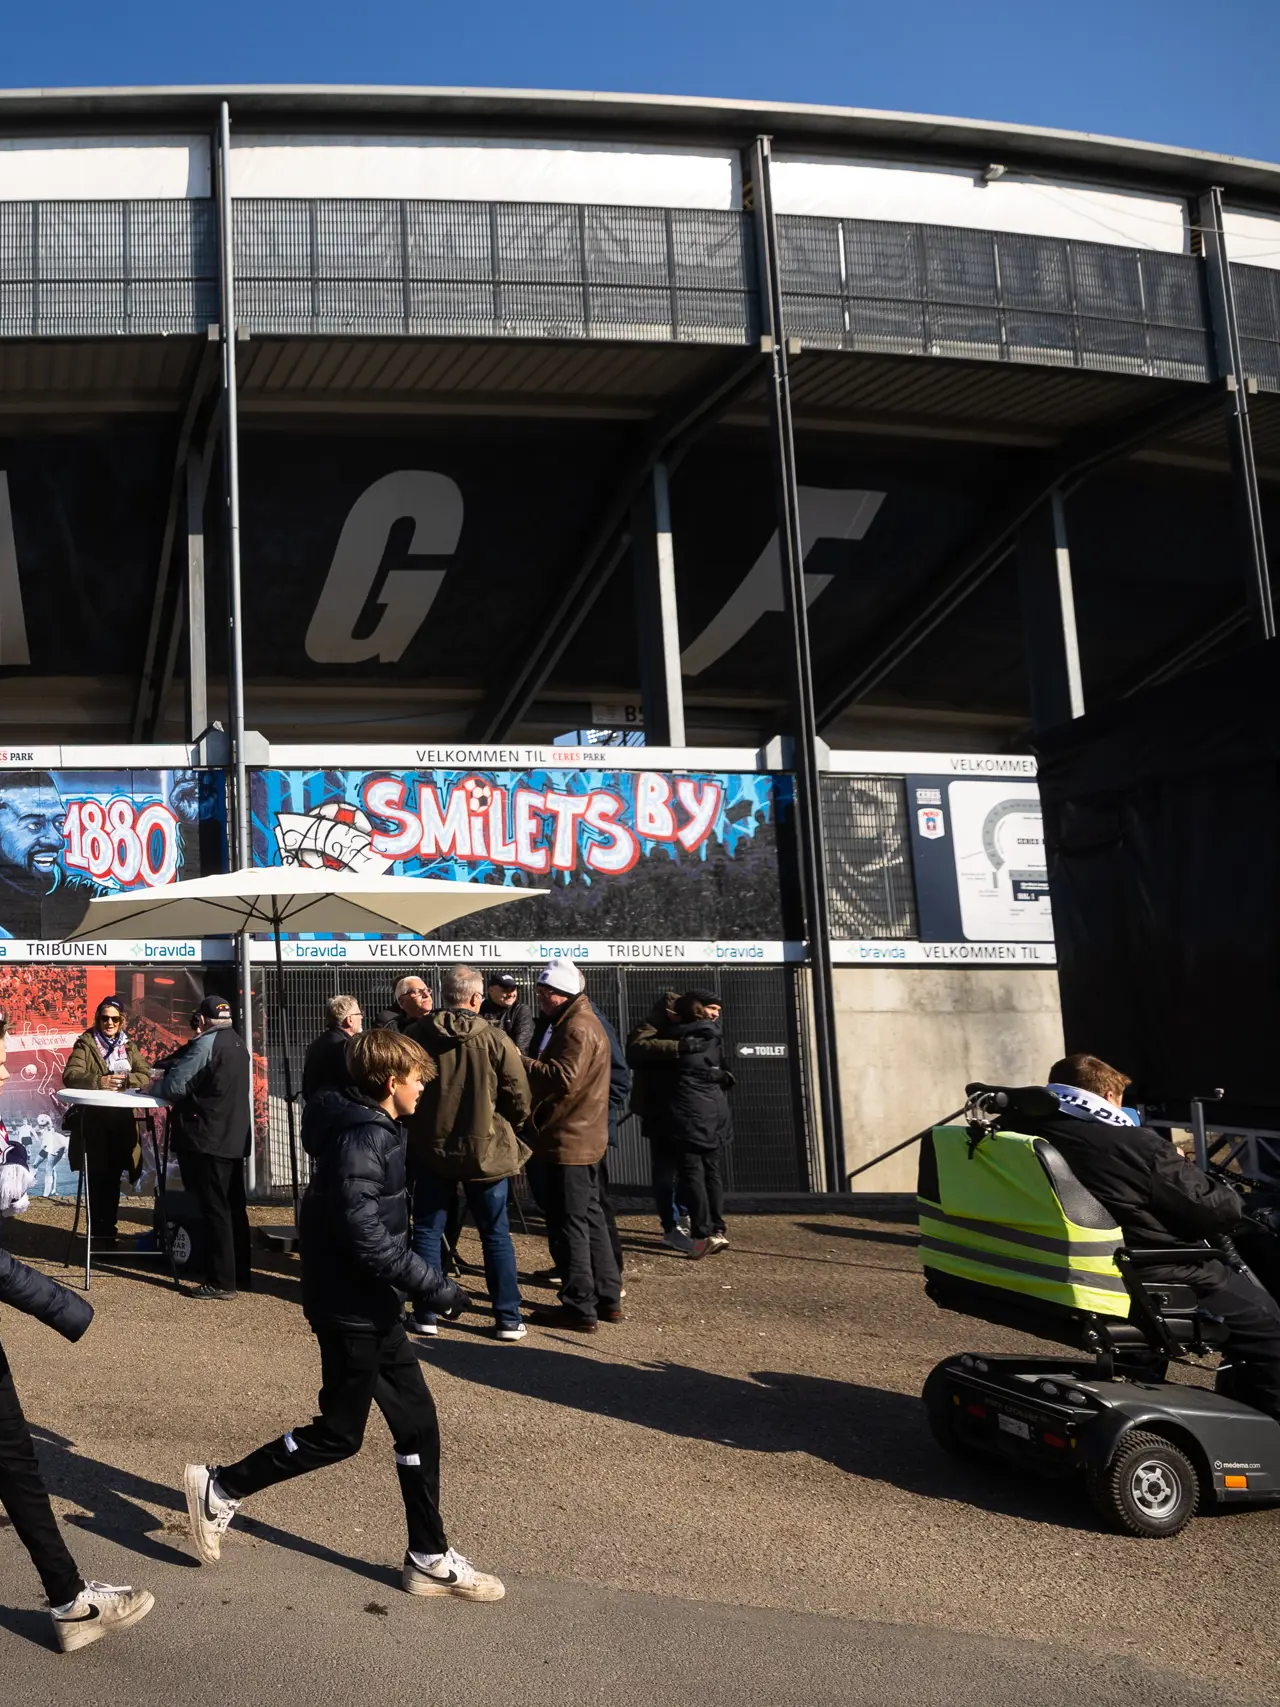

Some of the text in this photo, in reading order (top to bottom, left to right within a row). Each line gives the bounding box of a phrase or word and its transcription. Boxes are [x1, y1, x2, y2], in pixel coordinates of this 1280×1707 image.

[10, 752, 34, 761] PARK
[416, 750, 606, 763] VELKOMMEN TIL CERES PARK
[635, 770, 720, 852] BY
[62, 797, 179, 888] 1880
[27, 943, 107, 956] TRIBUNEN
[145, 943, 196, 957] bravida
[296, 943, 346, 957] bravida
[368, 944, 501, 957] VELKOMMEN TIL
[540, 944, 588, 957] bravida
[608, 945, 684, 957] TRIBUNEN
[716, 944, 764, 958] bravida
[860, 947, 906, 958] bravida
[922, 947, 1040, 959] VELKOMMEN TIL
[754, 1046, 786, 1056] TOILET
